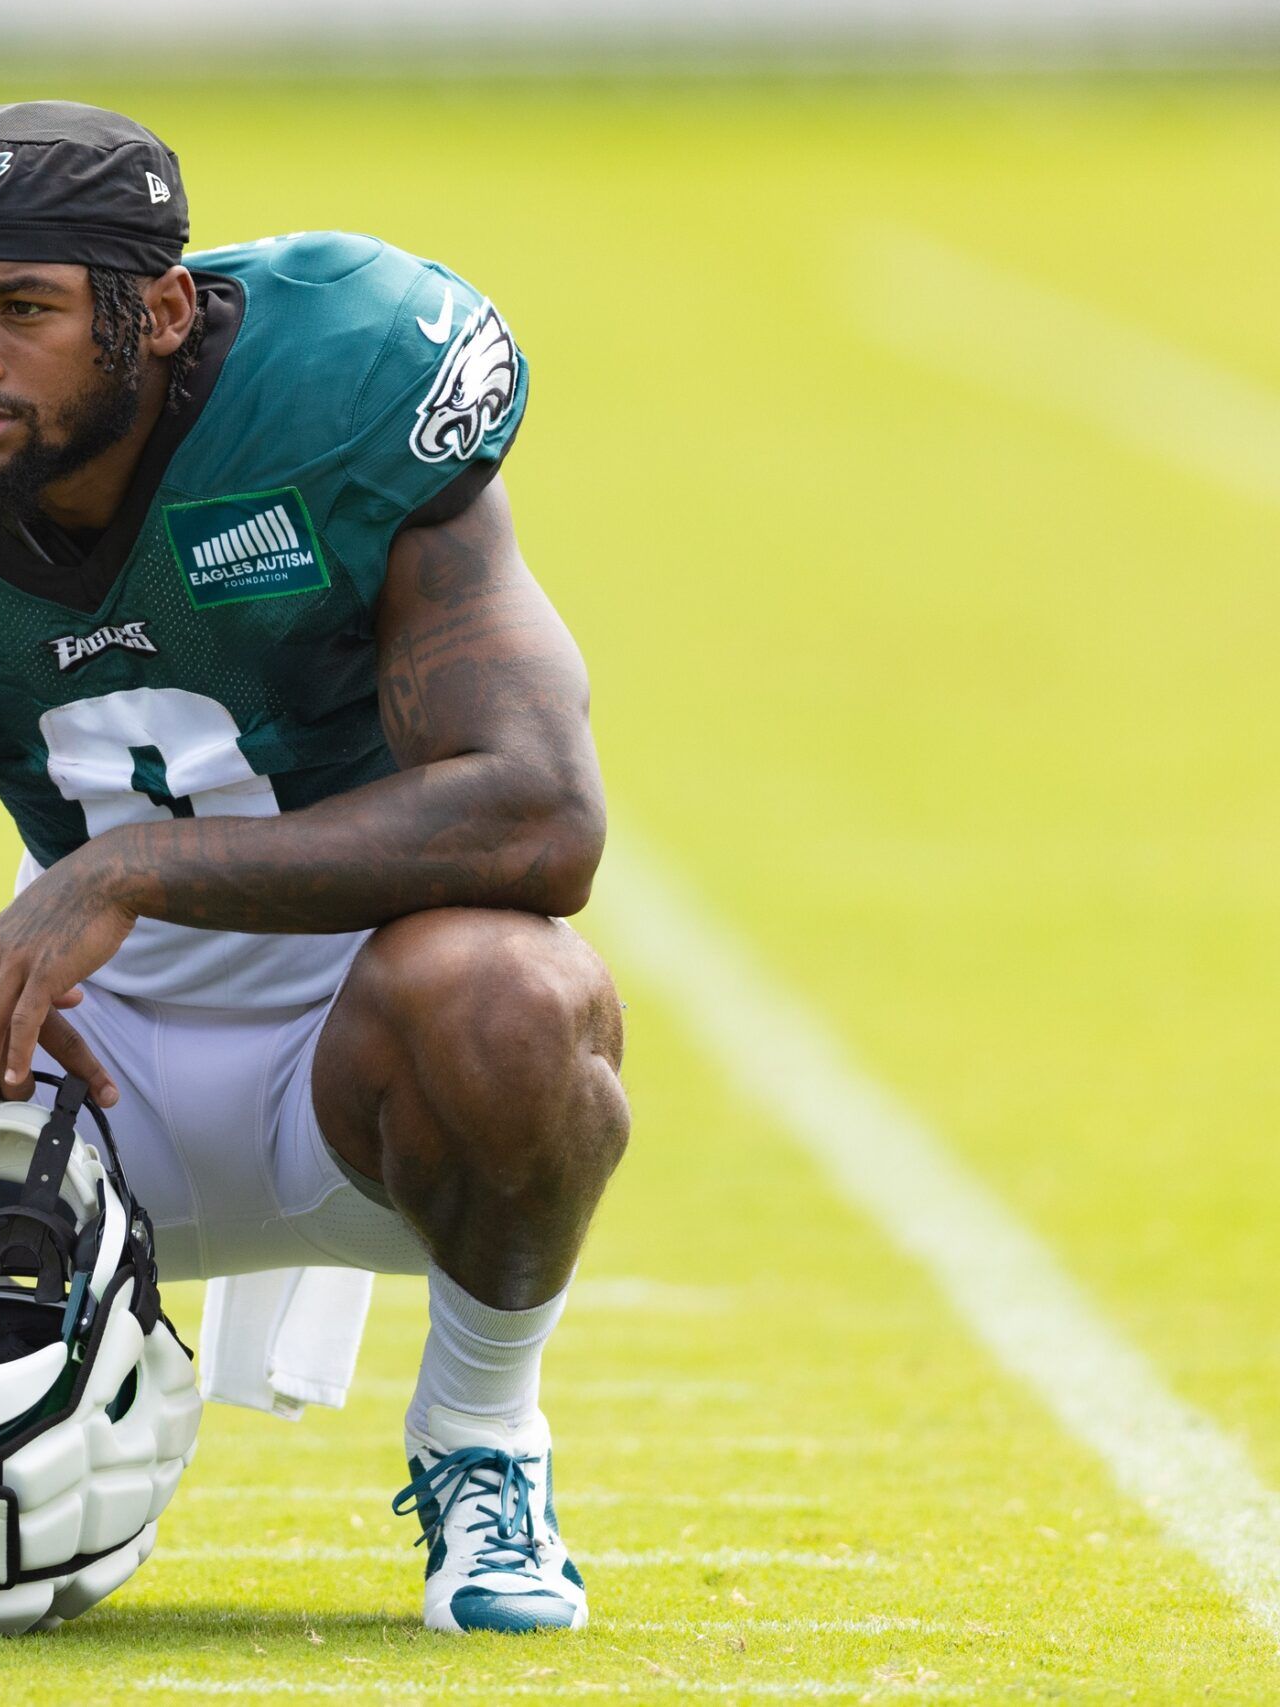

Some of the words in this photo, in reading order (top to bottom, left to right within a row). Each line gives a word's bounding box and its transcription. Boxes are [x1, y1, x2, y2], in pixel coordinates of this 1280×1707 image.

[189, 561, 254, 586] EAGLES
[256, 550, 314, 572] AUTISM
[224, 572, 289, 588] FOUNDATION
[48, 621, 157, 671] EAGLES
